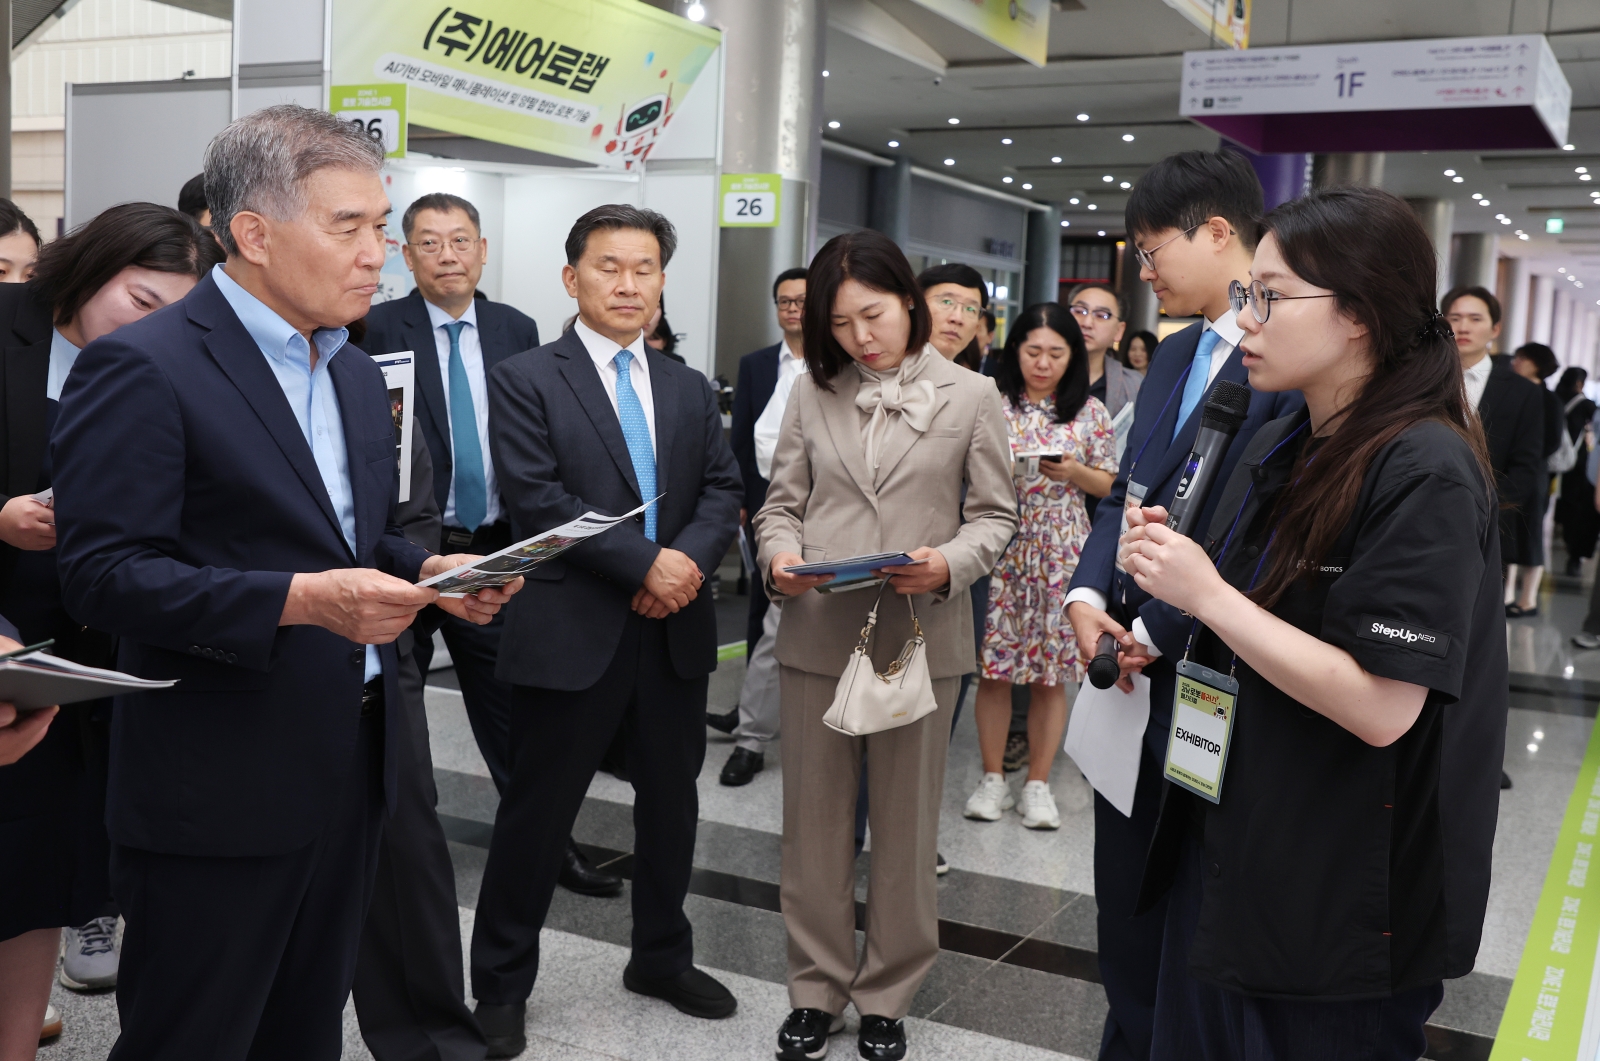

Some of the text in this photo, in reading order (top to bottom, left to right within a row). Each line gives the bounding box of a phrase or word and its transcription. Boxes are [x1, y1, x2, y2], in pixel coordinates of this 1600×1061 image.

[423, 6, 611, 94] (주)에어로랩
[383, 61, 421, 81] AI기반
[418, 68, 454, 89] 모바일
[507, 92, 521, 105] 및
[518, 95, 540, 111] 양팔
[536, 99, 559, 116] 협업
[554, 104, 575, 120] 로봇
[572, 108, 591, 123] 기술
[1334, 71, 1366, 98] 1F
[736, 198, 762, 216] 26
[1371, 622, 1418, 643] StepUp
[1175, 726, 1221, 756] EXHIBITOR
